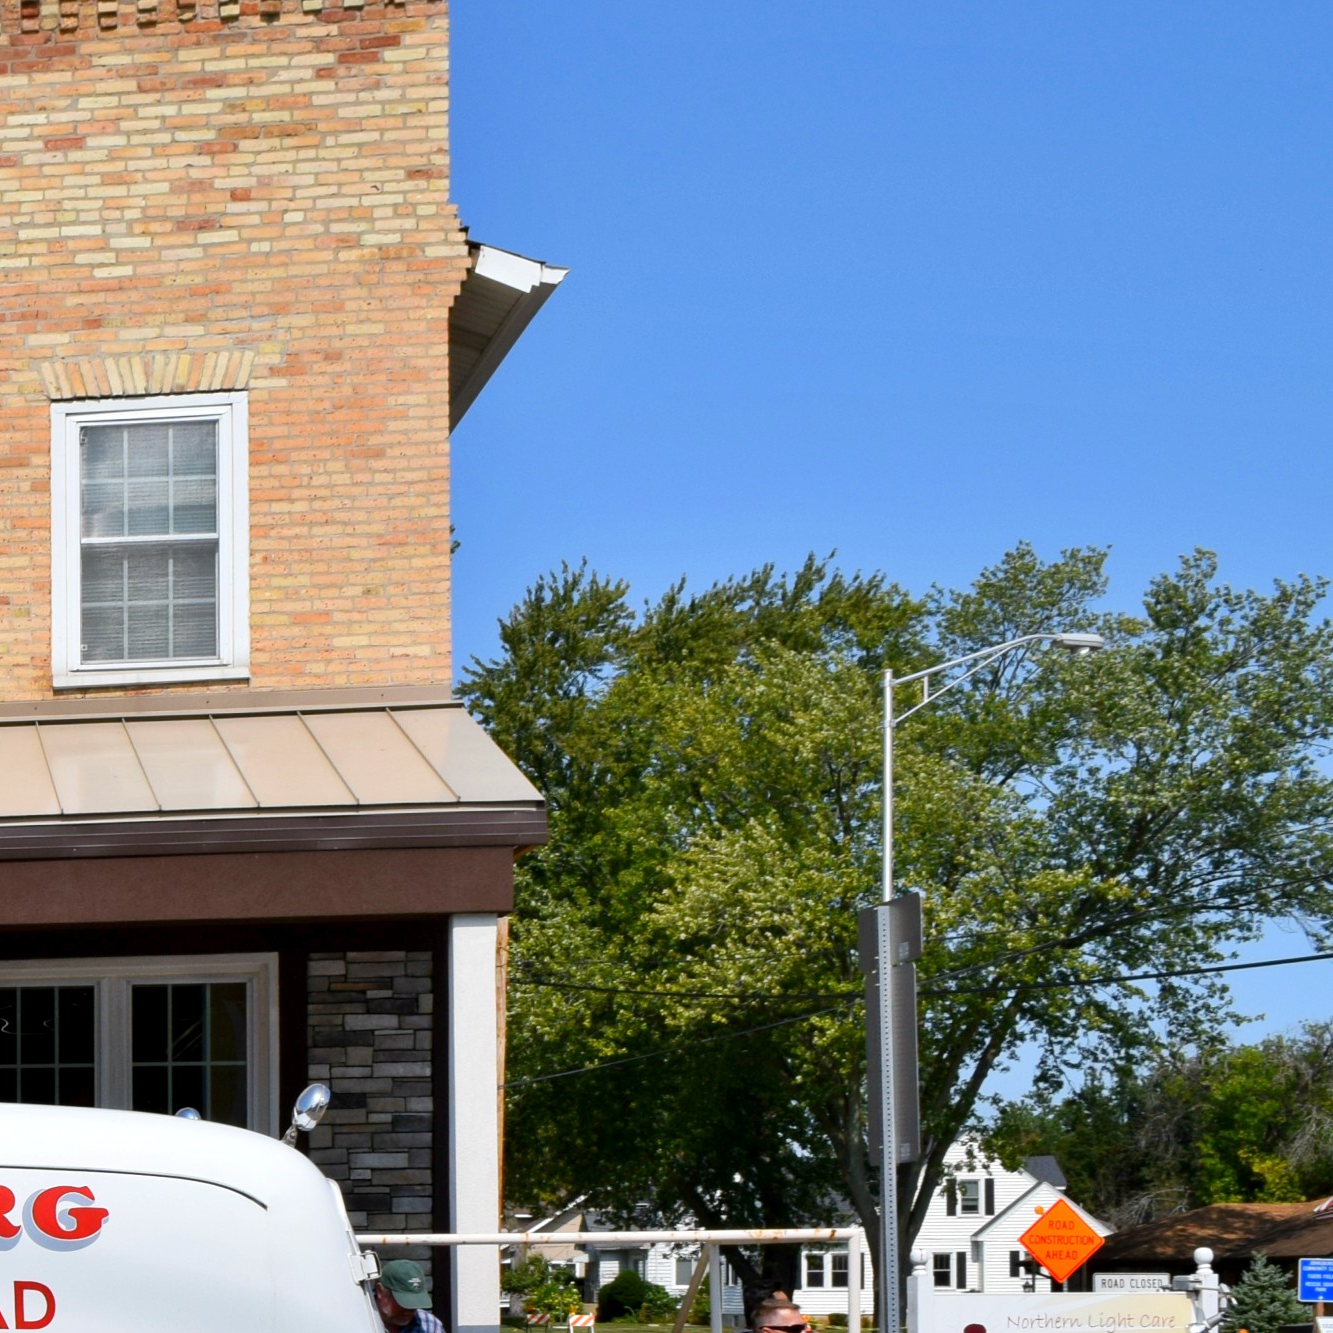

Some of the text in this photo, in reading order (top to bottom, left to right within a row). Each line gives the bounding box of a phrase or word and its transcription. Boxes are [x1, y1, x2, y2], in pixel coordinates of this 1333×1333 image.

[1048, 1220, 1075, 1231] ROAD
[1028, 1234, 1095, 1246] CONSTRUCTION
[1044, 1249, 1079, 1260] AHEAD
[1101, 1278, 1164, 1289] ROAD CLOSED
[1006, 1312, 1177, 1333] Northern Light Care
